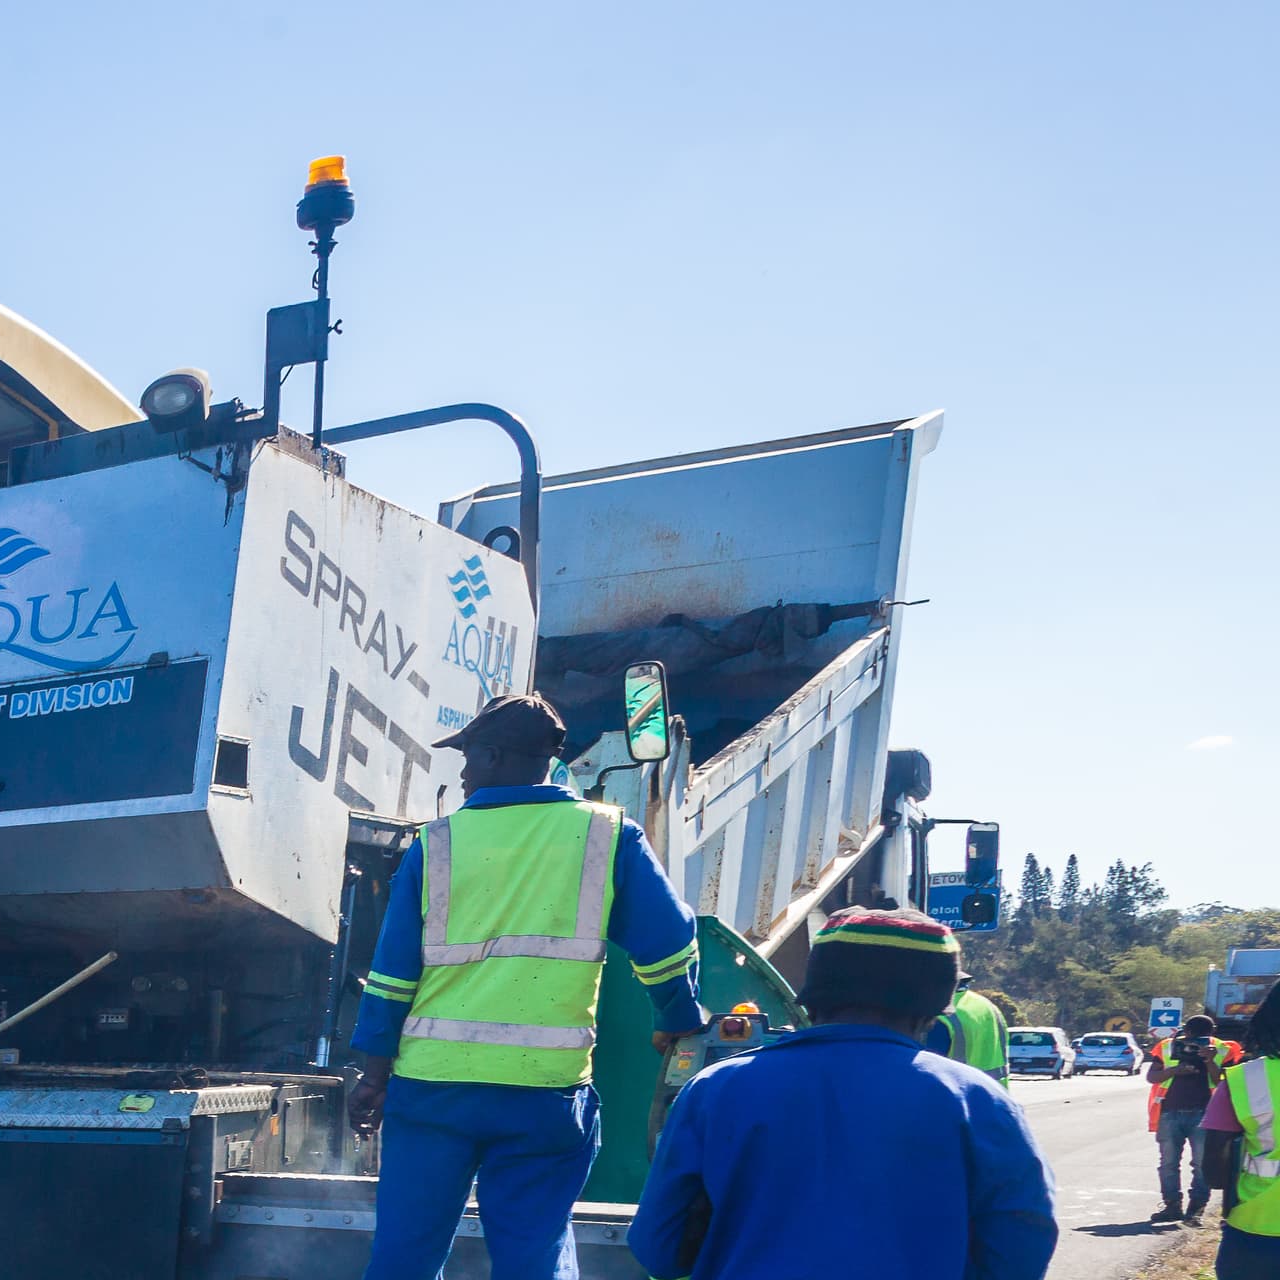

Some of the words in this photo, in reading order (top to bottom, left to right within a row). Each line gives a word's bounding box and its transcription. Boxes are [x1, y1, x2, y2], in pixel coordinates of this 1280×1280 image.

[280, 509, 430, 698] SPRAY-
[442, 616, 513, 699] AQUA
[9, 676, 134, 719] DIVISION
[288, 665, 432, 817] JET
